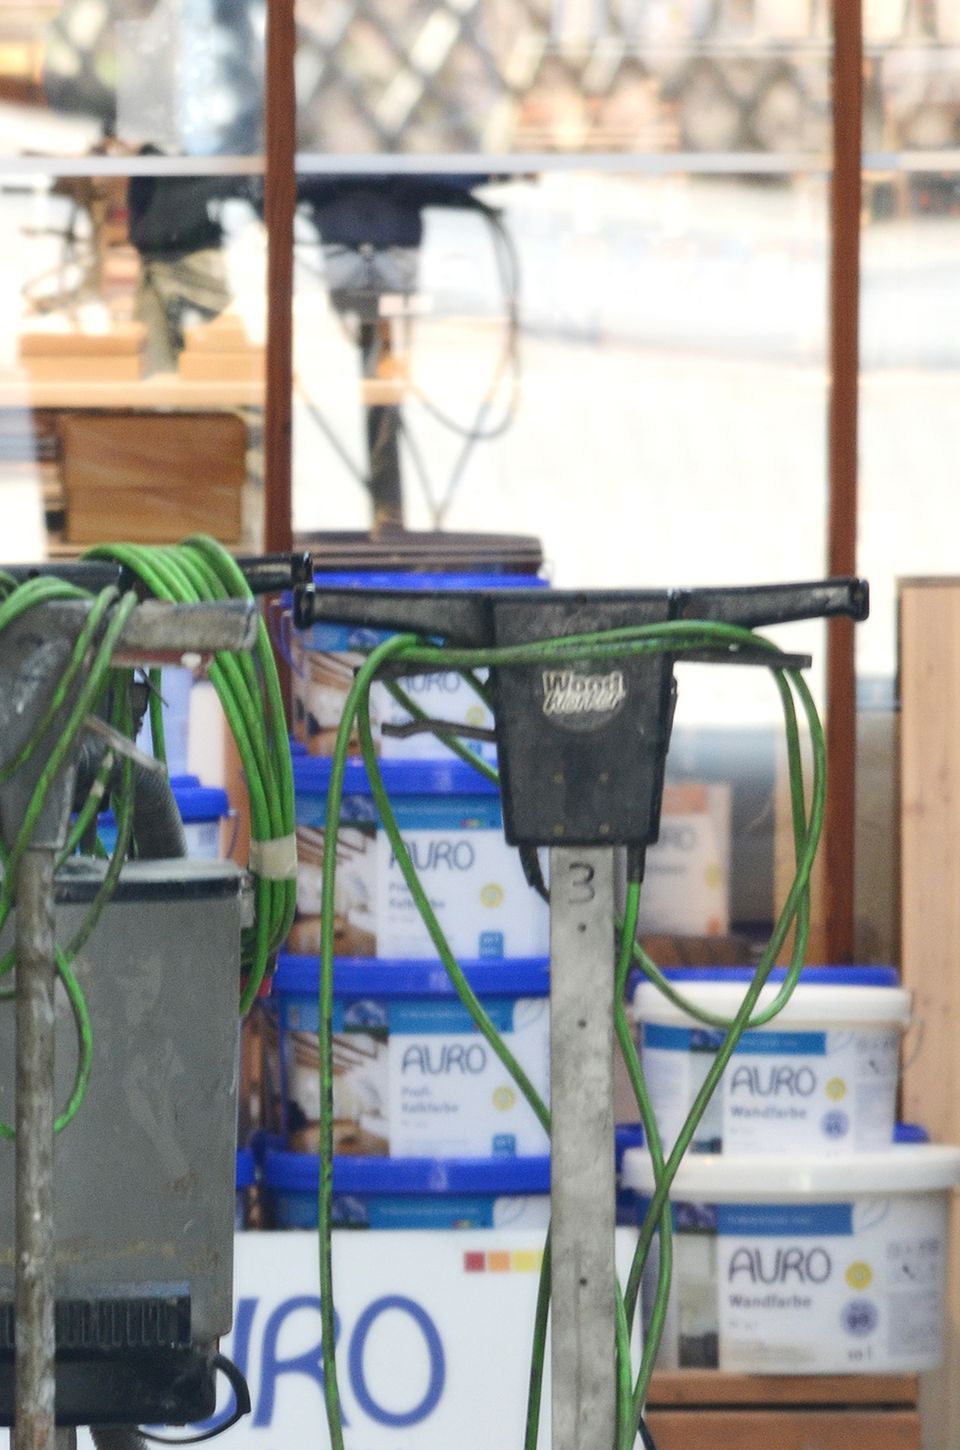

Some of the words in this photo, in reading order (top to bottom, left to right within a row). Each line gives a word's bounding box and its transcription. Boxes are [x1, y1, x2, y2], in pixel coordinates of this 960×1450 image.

[542, 671, 622, 695] Wood
[568, 862, 596, 904] 3
[401, 1043, 487, 1074] AURO
[730, 1065, 817, 1096] AURO
[730, 1104, 807, 1119] Wandfarbe
[728, 1247, 832, 1284] AURO
[729, 1292, 812, 1309] Wandfarbe
[180, 1294, 447, 1430] URO
